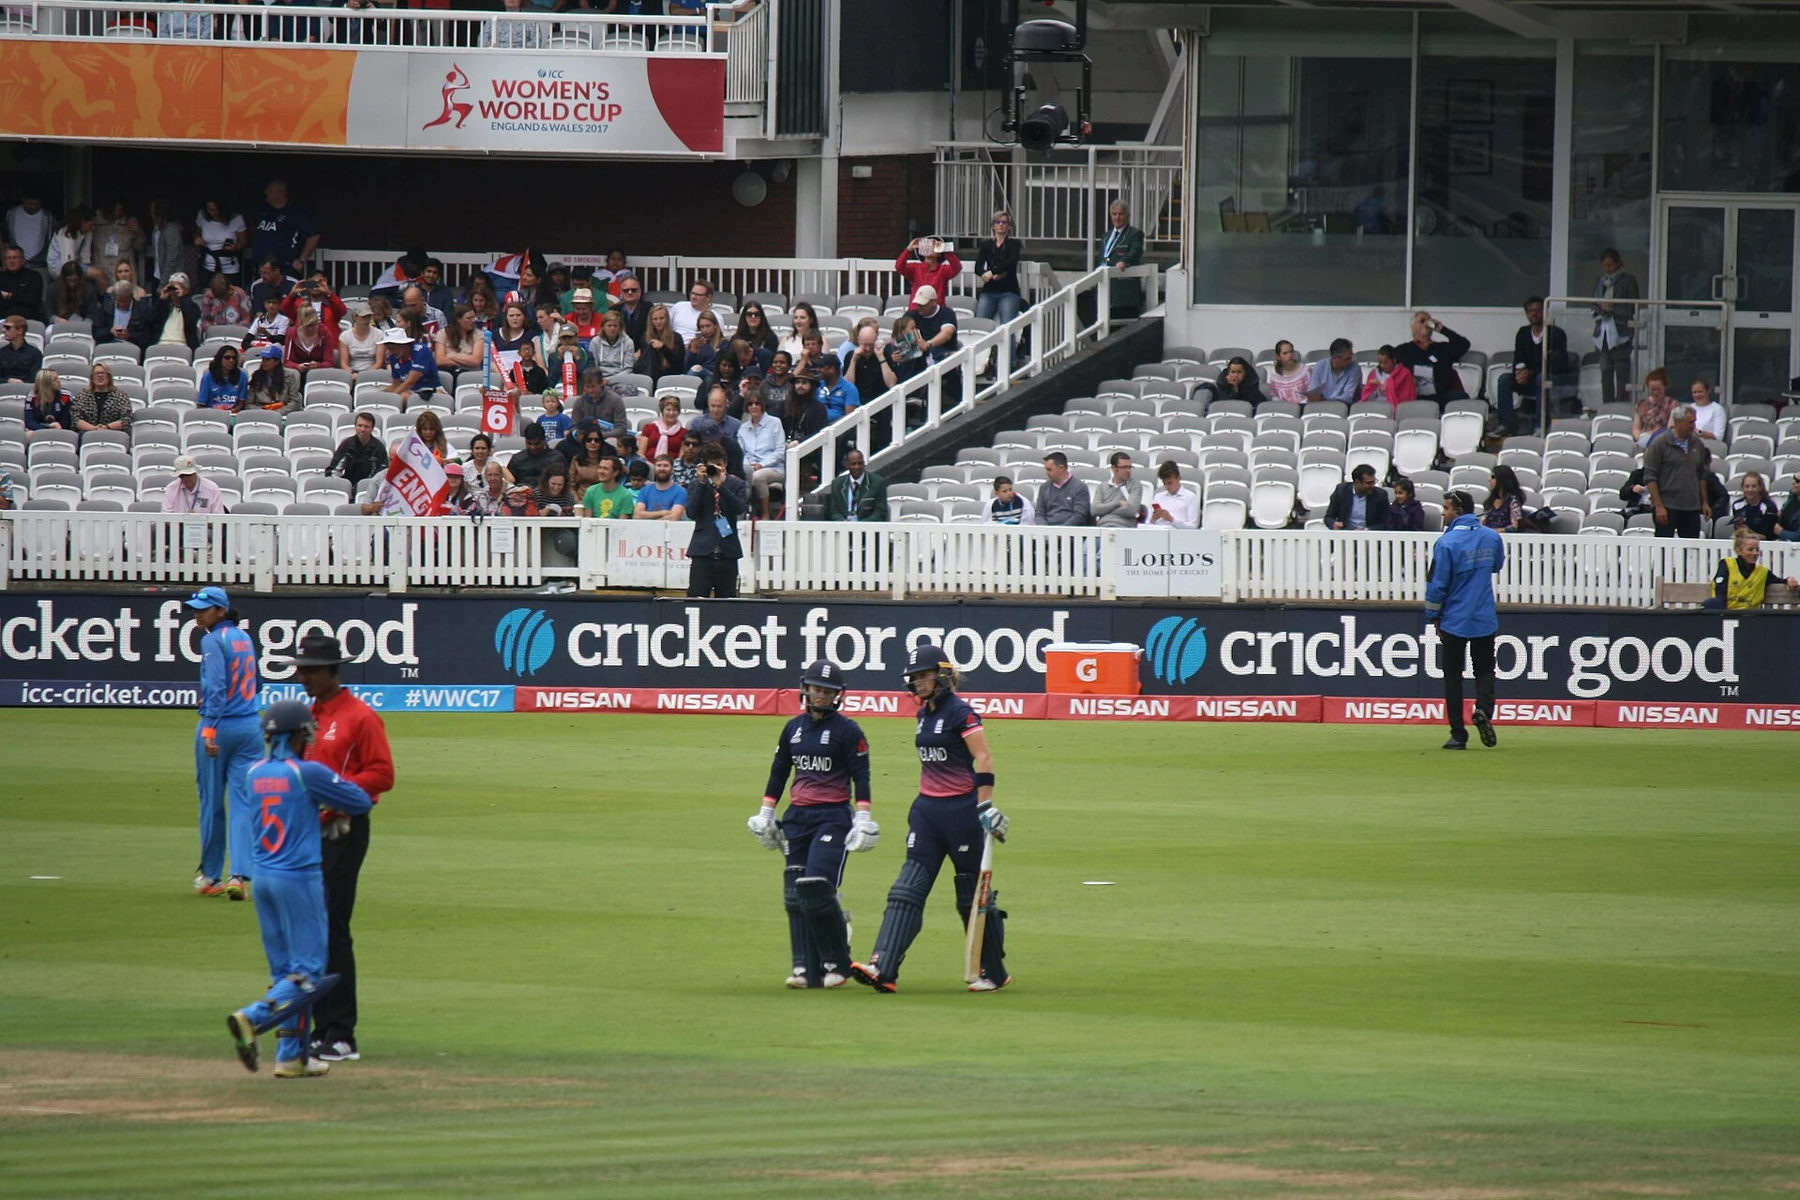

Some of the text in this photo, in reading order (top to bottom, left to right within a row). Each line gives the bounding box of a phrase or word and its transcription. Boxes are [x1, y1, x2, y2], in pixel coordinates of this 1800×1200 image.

[548, 70, 564, 79] ICC
[491, 80, 610, 100] WOMEN'S
[478, 100, 623, 122] WORLD CUP
[491, 122, 609, 133] ENGLAND & WALES 2017
[257, 220, 277, 231] AIA
[487, 405, 508, 430] 6
[0, 600, 419, 680] cket fo good
[567, 607, 788, 669] cricket
[800, 608, 897, 671] for
[1220, 615, 1445, 678] cricket
[1567, 619, 1740, 698] good
[227, 655, 257, 702] 18
[401, 668, 419, 678] TM
[1075, 658, 1098, 682] G
[22, 682, 198, 705] icc-cricket.com
[260, 686, 317, 706] follo
[405, 690, 500, 708] #WWC17
[535, 691, 632, 708] NISSAN
[1719, 685, 1739, 696] TM
[657, 693, 755, 710] NISSAN
[800, 695, 898, 713] SAN
[961, 698, 1024, 714] SAN
[1070, 699, 1169, 716] NISSAN
[1196, 700, 1297, 717] NISSAN
[1345, 702, 1445, 720] NISSAN
[1473, 704, 1572, 721] ISSAN
[1618, 706, 1719, 724] NISSAN
[260, 796, 286, 854] 5
